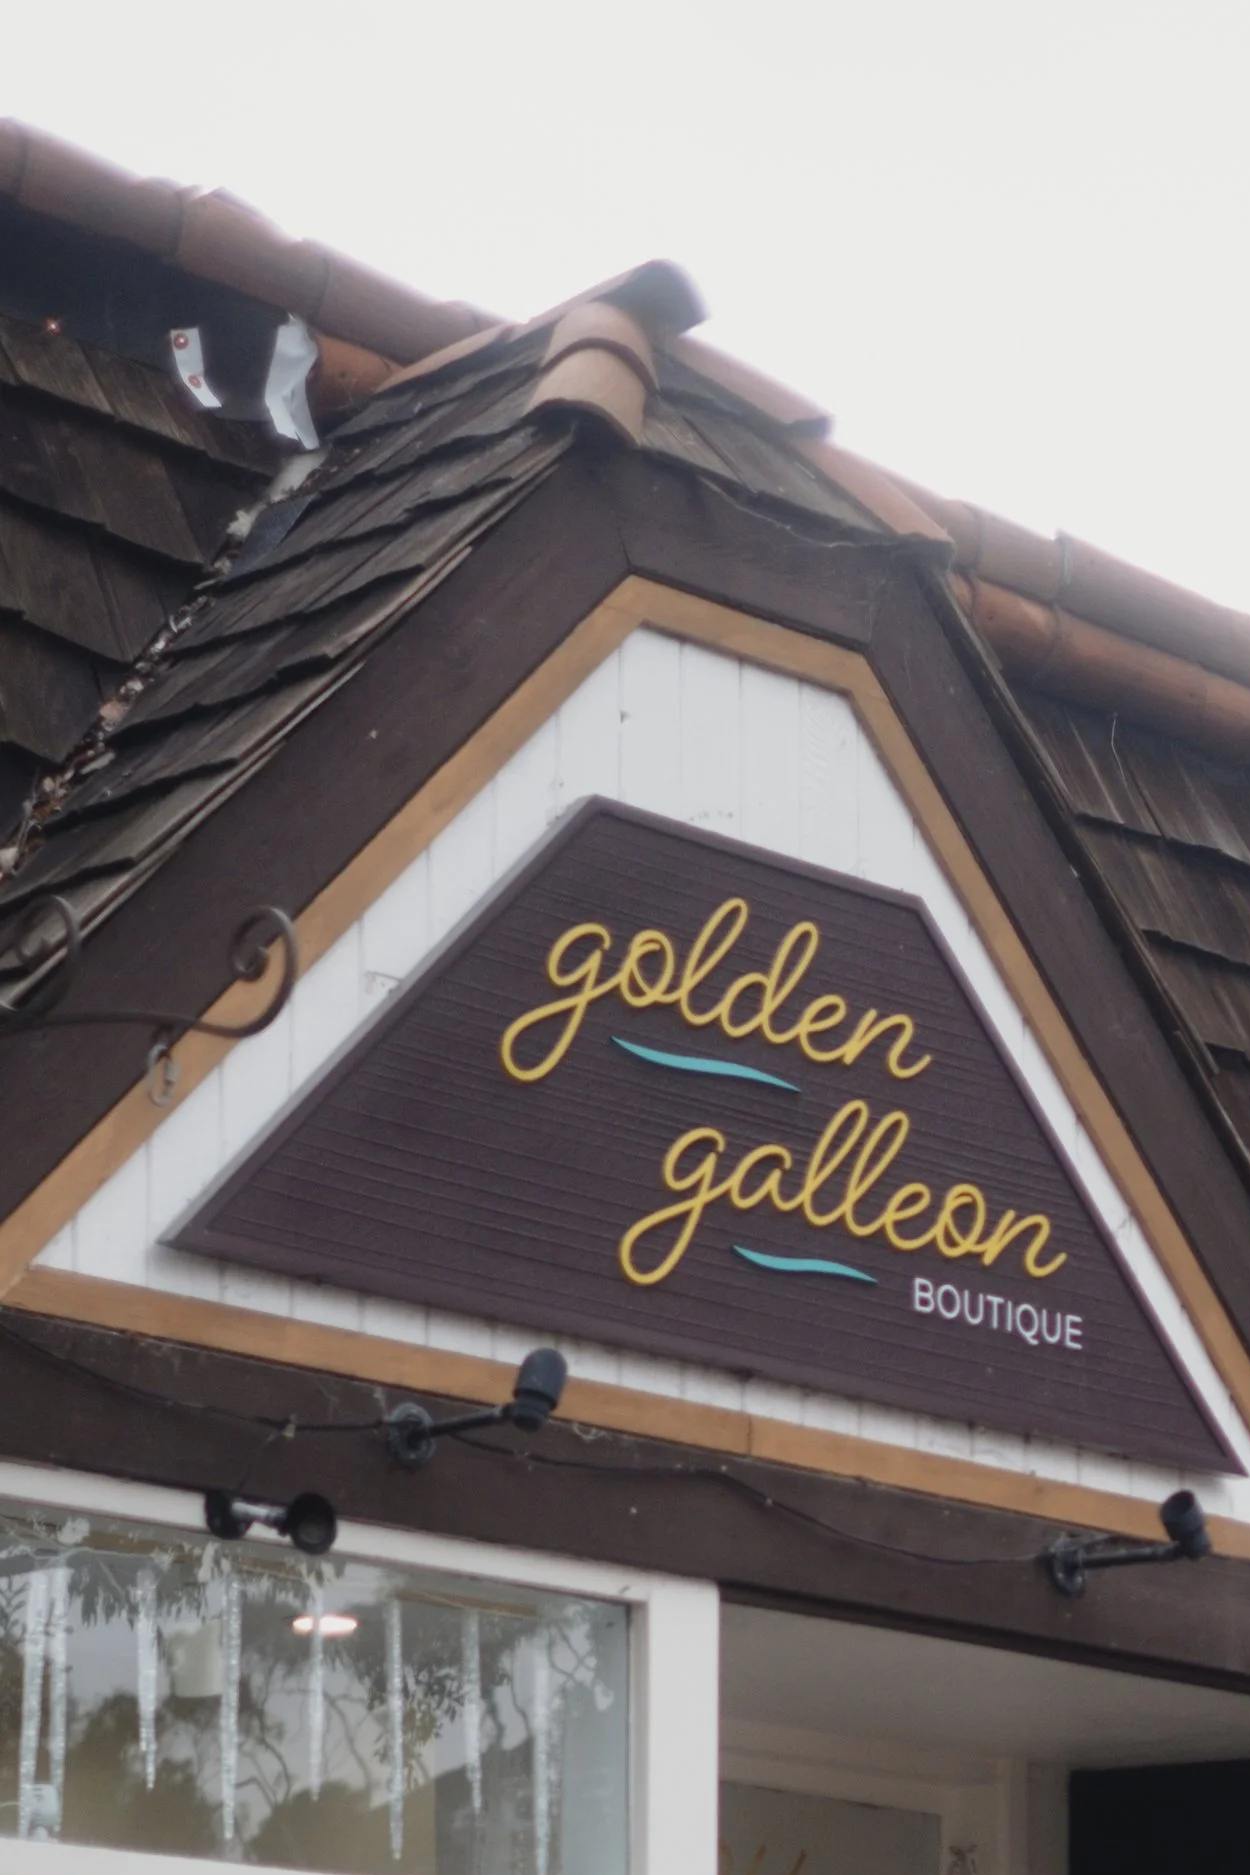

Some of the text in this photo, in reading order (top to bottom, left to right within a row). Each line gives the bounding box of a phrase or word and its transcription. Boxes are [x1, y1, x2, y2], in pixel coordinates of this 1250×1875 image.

[501, 897, 933, 1082] golden
[618, 1100, 1068, 1287] galleon
[912, 1277, 1084, 1351] BOUTIQUE
